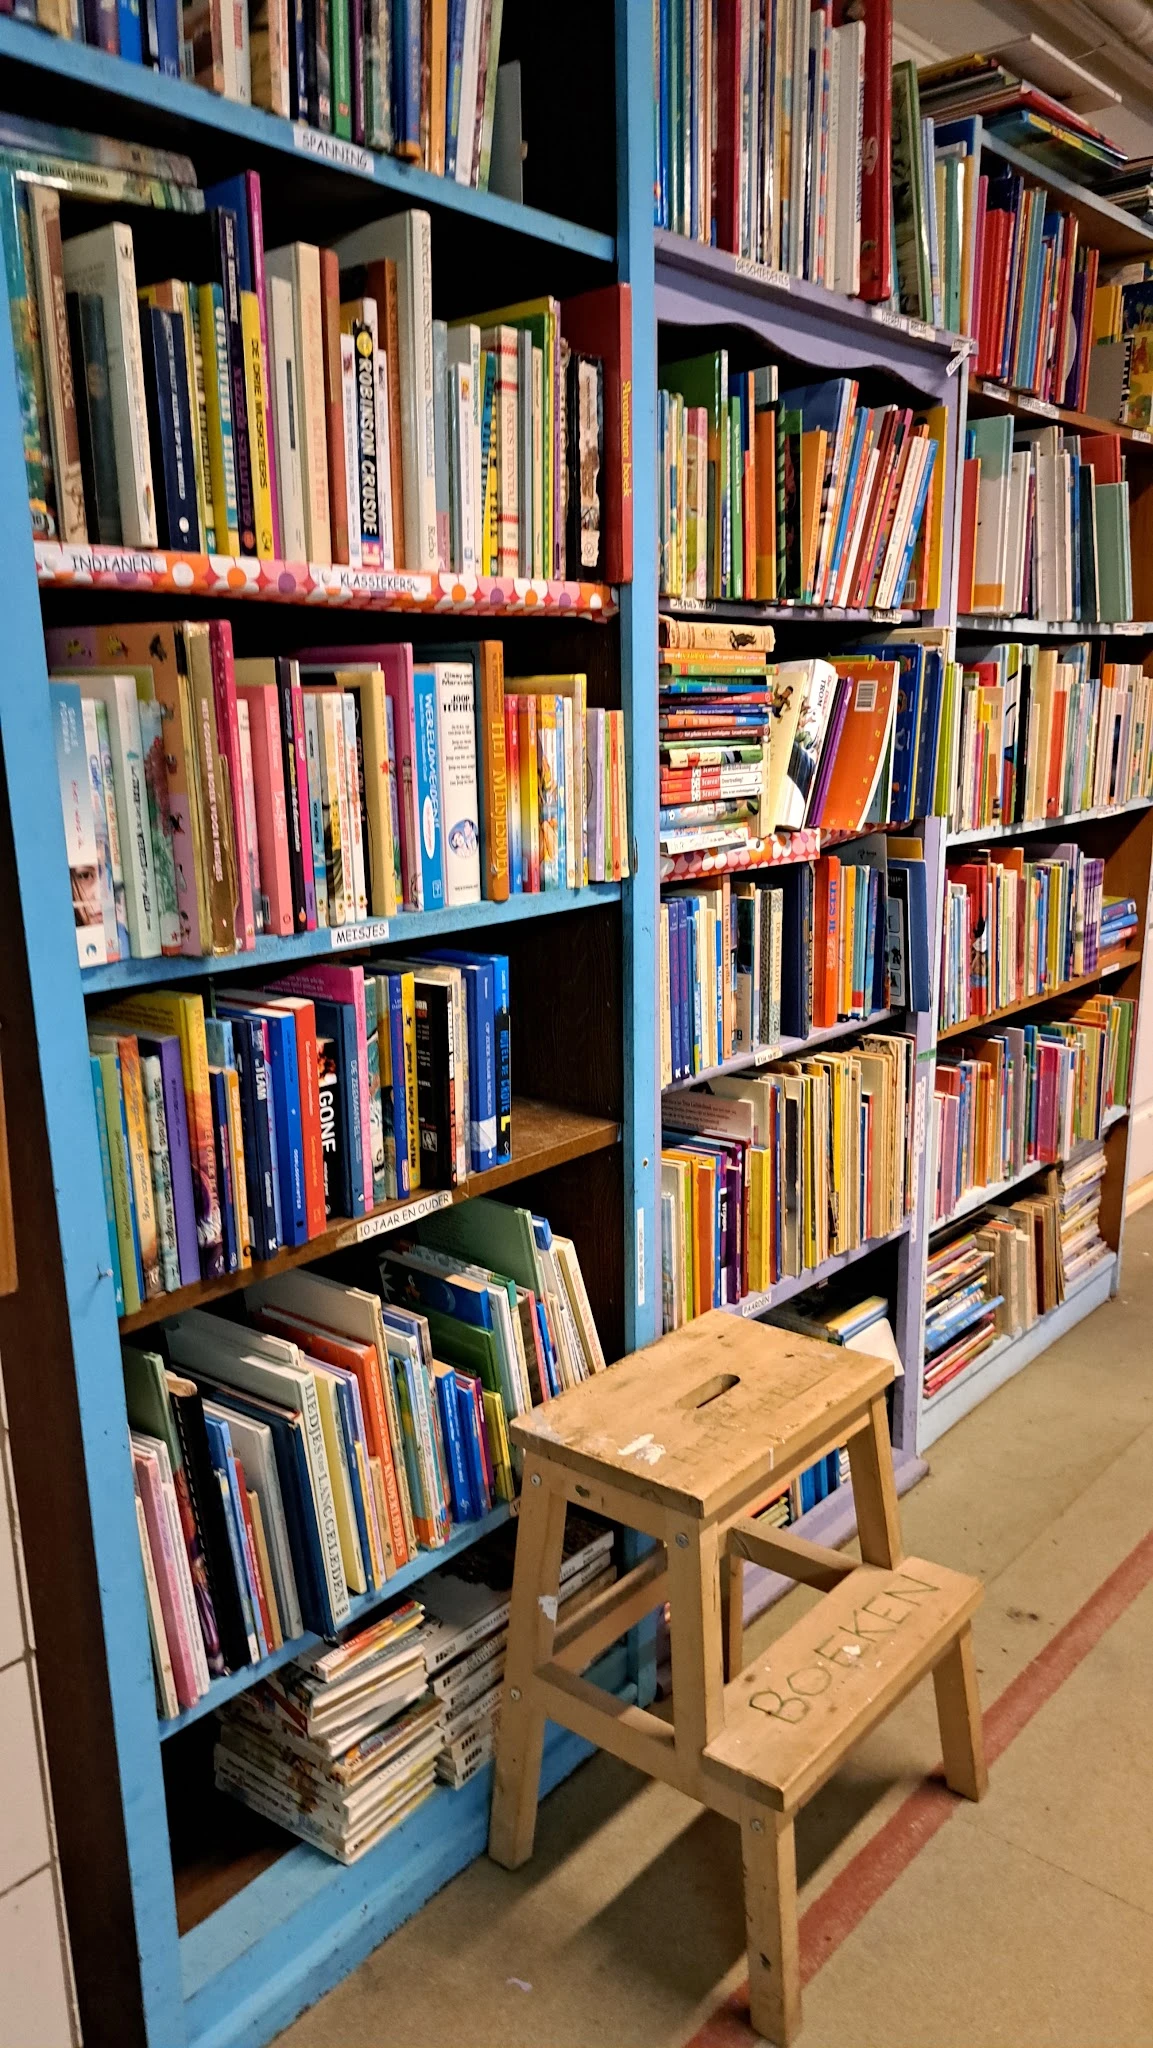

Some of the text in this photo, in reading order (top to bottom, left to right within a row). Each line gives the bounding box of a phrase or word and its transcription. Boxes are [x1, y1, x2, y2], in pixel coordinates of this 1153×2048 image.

[303, 133, 369, 169] SPANNING
[214, 306, 231, 421] GULLIVERS
[251, 339, 267, 488] DE DRIE MUSKETIERS
[621, 381, 632, 496] Avonturen boek
[358, 358, 378, 535] ROBINSON CRUSOE
[505, 448, 517, 506] TIENTAL
[71, 554, 152, 572] INDIANEN
[340, 575, 413, 591] KLASSIEKERS
[817, 679, 826, 707] TROM
[200, 697, 223, 882] HET GOUDEN BOEK VOOR MEISJES
[489, 717, 509, 880] HET MEISJESBOEK
[336, 923, 386, 943] MEISJES
[775, 922, 780, 934] DE
[500, 1030, 508, 1062] HOTEL
[319, 1090, 335, 1152] GONE
[359, 1193, 450, 1237] 10 JAAR EN OUDER
[743, 1294, 770, 1315] PAARDEN
[304, 1382, 326, 1456] LIEDJES
[316, 1472, 334, 1520] LANG
[385, 1462, 406, 1556] KINDERLIEDJES
[323, 1518, 346, 1604] GELEDEN
[749, 1574, 941, 1724] BOEKEN
